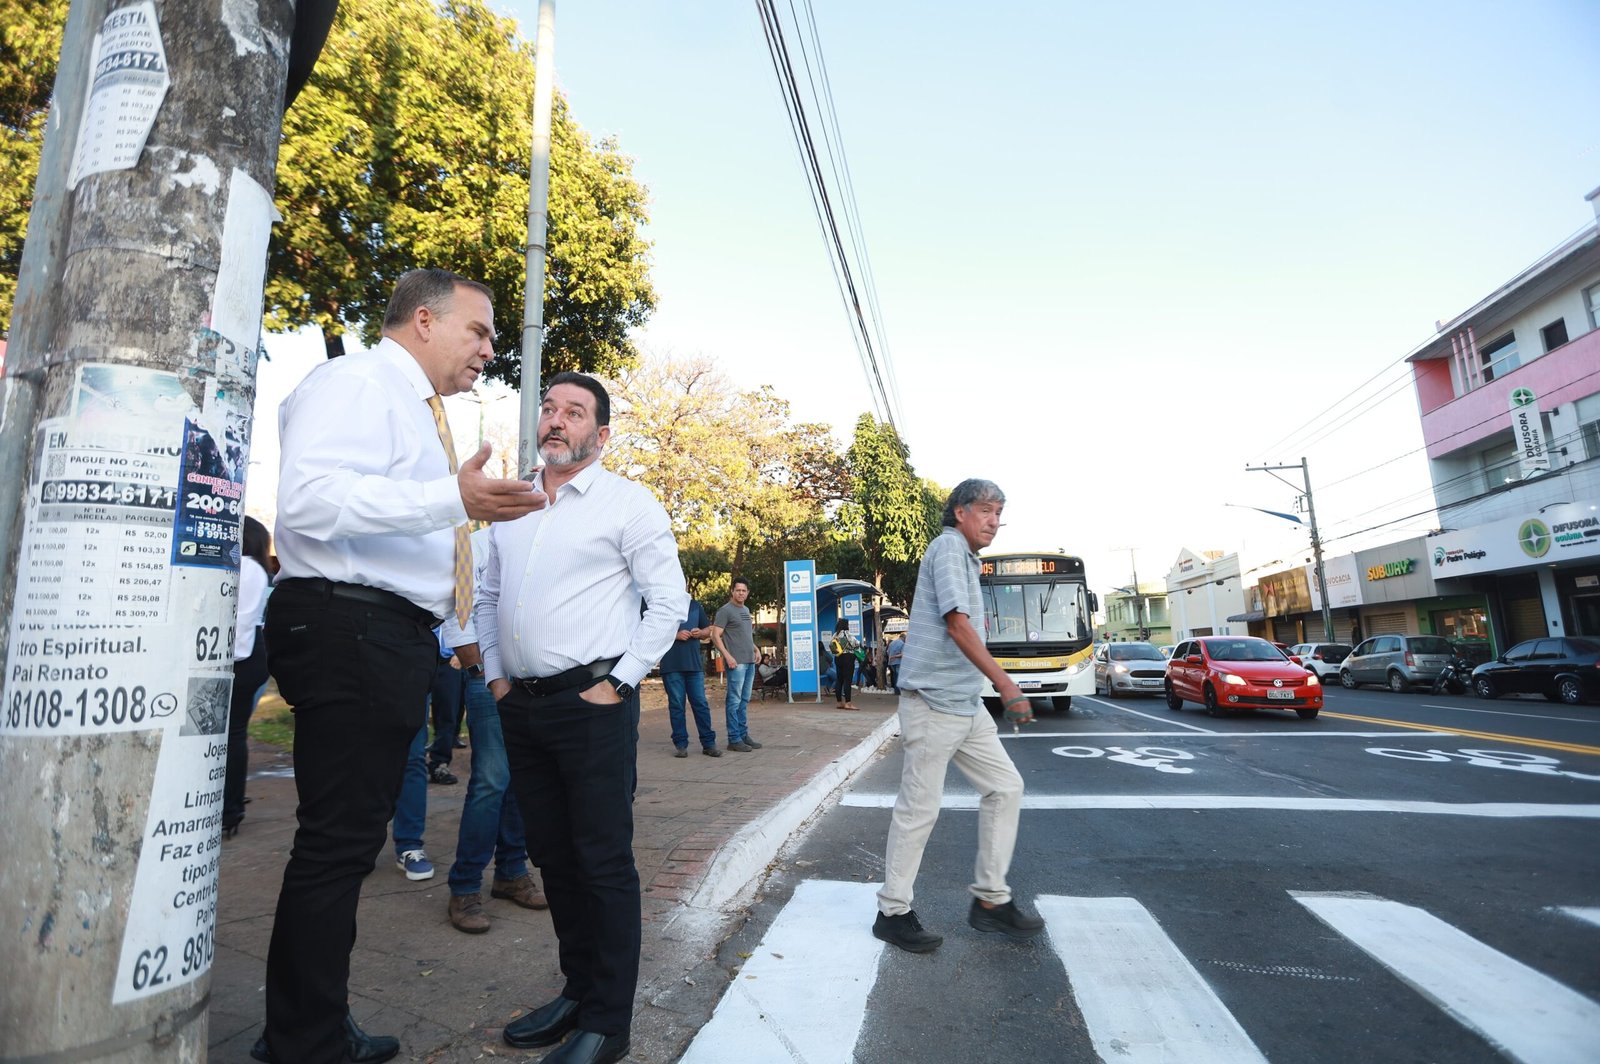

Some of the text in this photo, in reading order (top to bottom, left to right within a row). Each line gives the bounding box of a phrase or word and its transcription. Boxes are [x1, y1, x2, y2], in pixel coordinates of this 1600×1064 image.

[1519, 412, 1535, 458] DIFUSORA
[70, 455, 106, 464] PAGUE
[86, 468, 101, 476] DE
[186, 492, 224, 512] 200
[198, 521, 222, 532] 3295
[1552, 517, 1600, 534] DIFUSORA
[144, 531, 168, 539] 52,00
[138, 546, 166, 555] 103,33
[136, 563, 164, 571] 154,85
[1367, 559, 1414, 581] SUBWAY
[134, 578, 162, 587] 206,47
[132, 595, 160, 603] 258,08
[130, 610, 158, 618] 309,70
[43, 636, 148, 659] Espiritual.
[196, 626, 222, 661] 62.
[12, 664, 108, 682] Pai Renato
[160, 844, 193, 862] Faz
[197, 842, 204, 854] e
[182, 864, 207, 884] tipo
[132, 946, 172, 990] 62.
